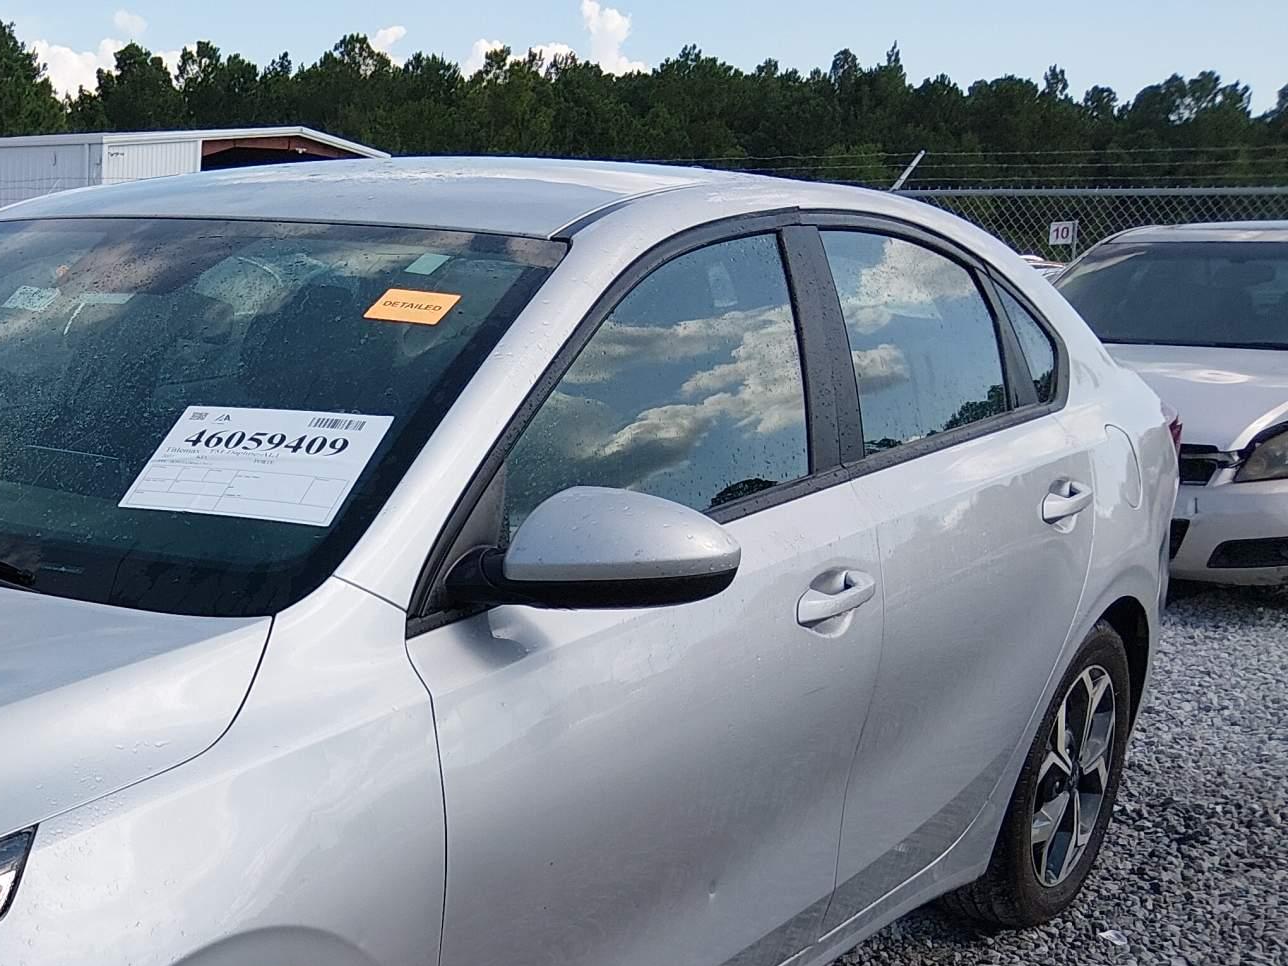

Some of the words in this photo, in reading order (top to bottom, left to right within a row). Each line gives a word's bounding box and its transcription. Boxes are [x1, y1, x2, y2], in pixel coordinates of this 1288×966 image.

[1053, 226, 1070, 240] 10
[383, 300, 442, 312] DETAILED
[184, 428, 349, 457] 46059409
